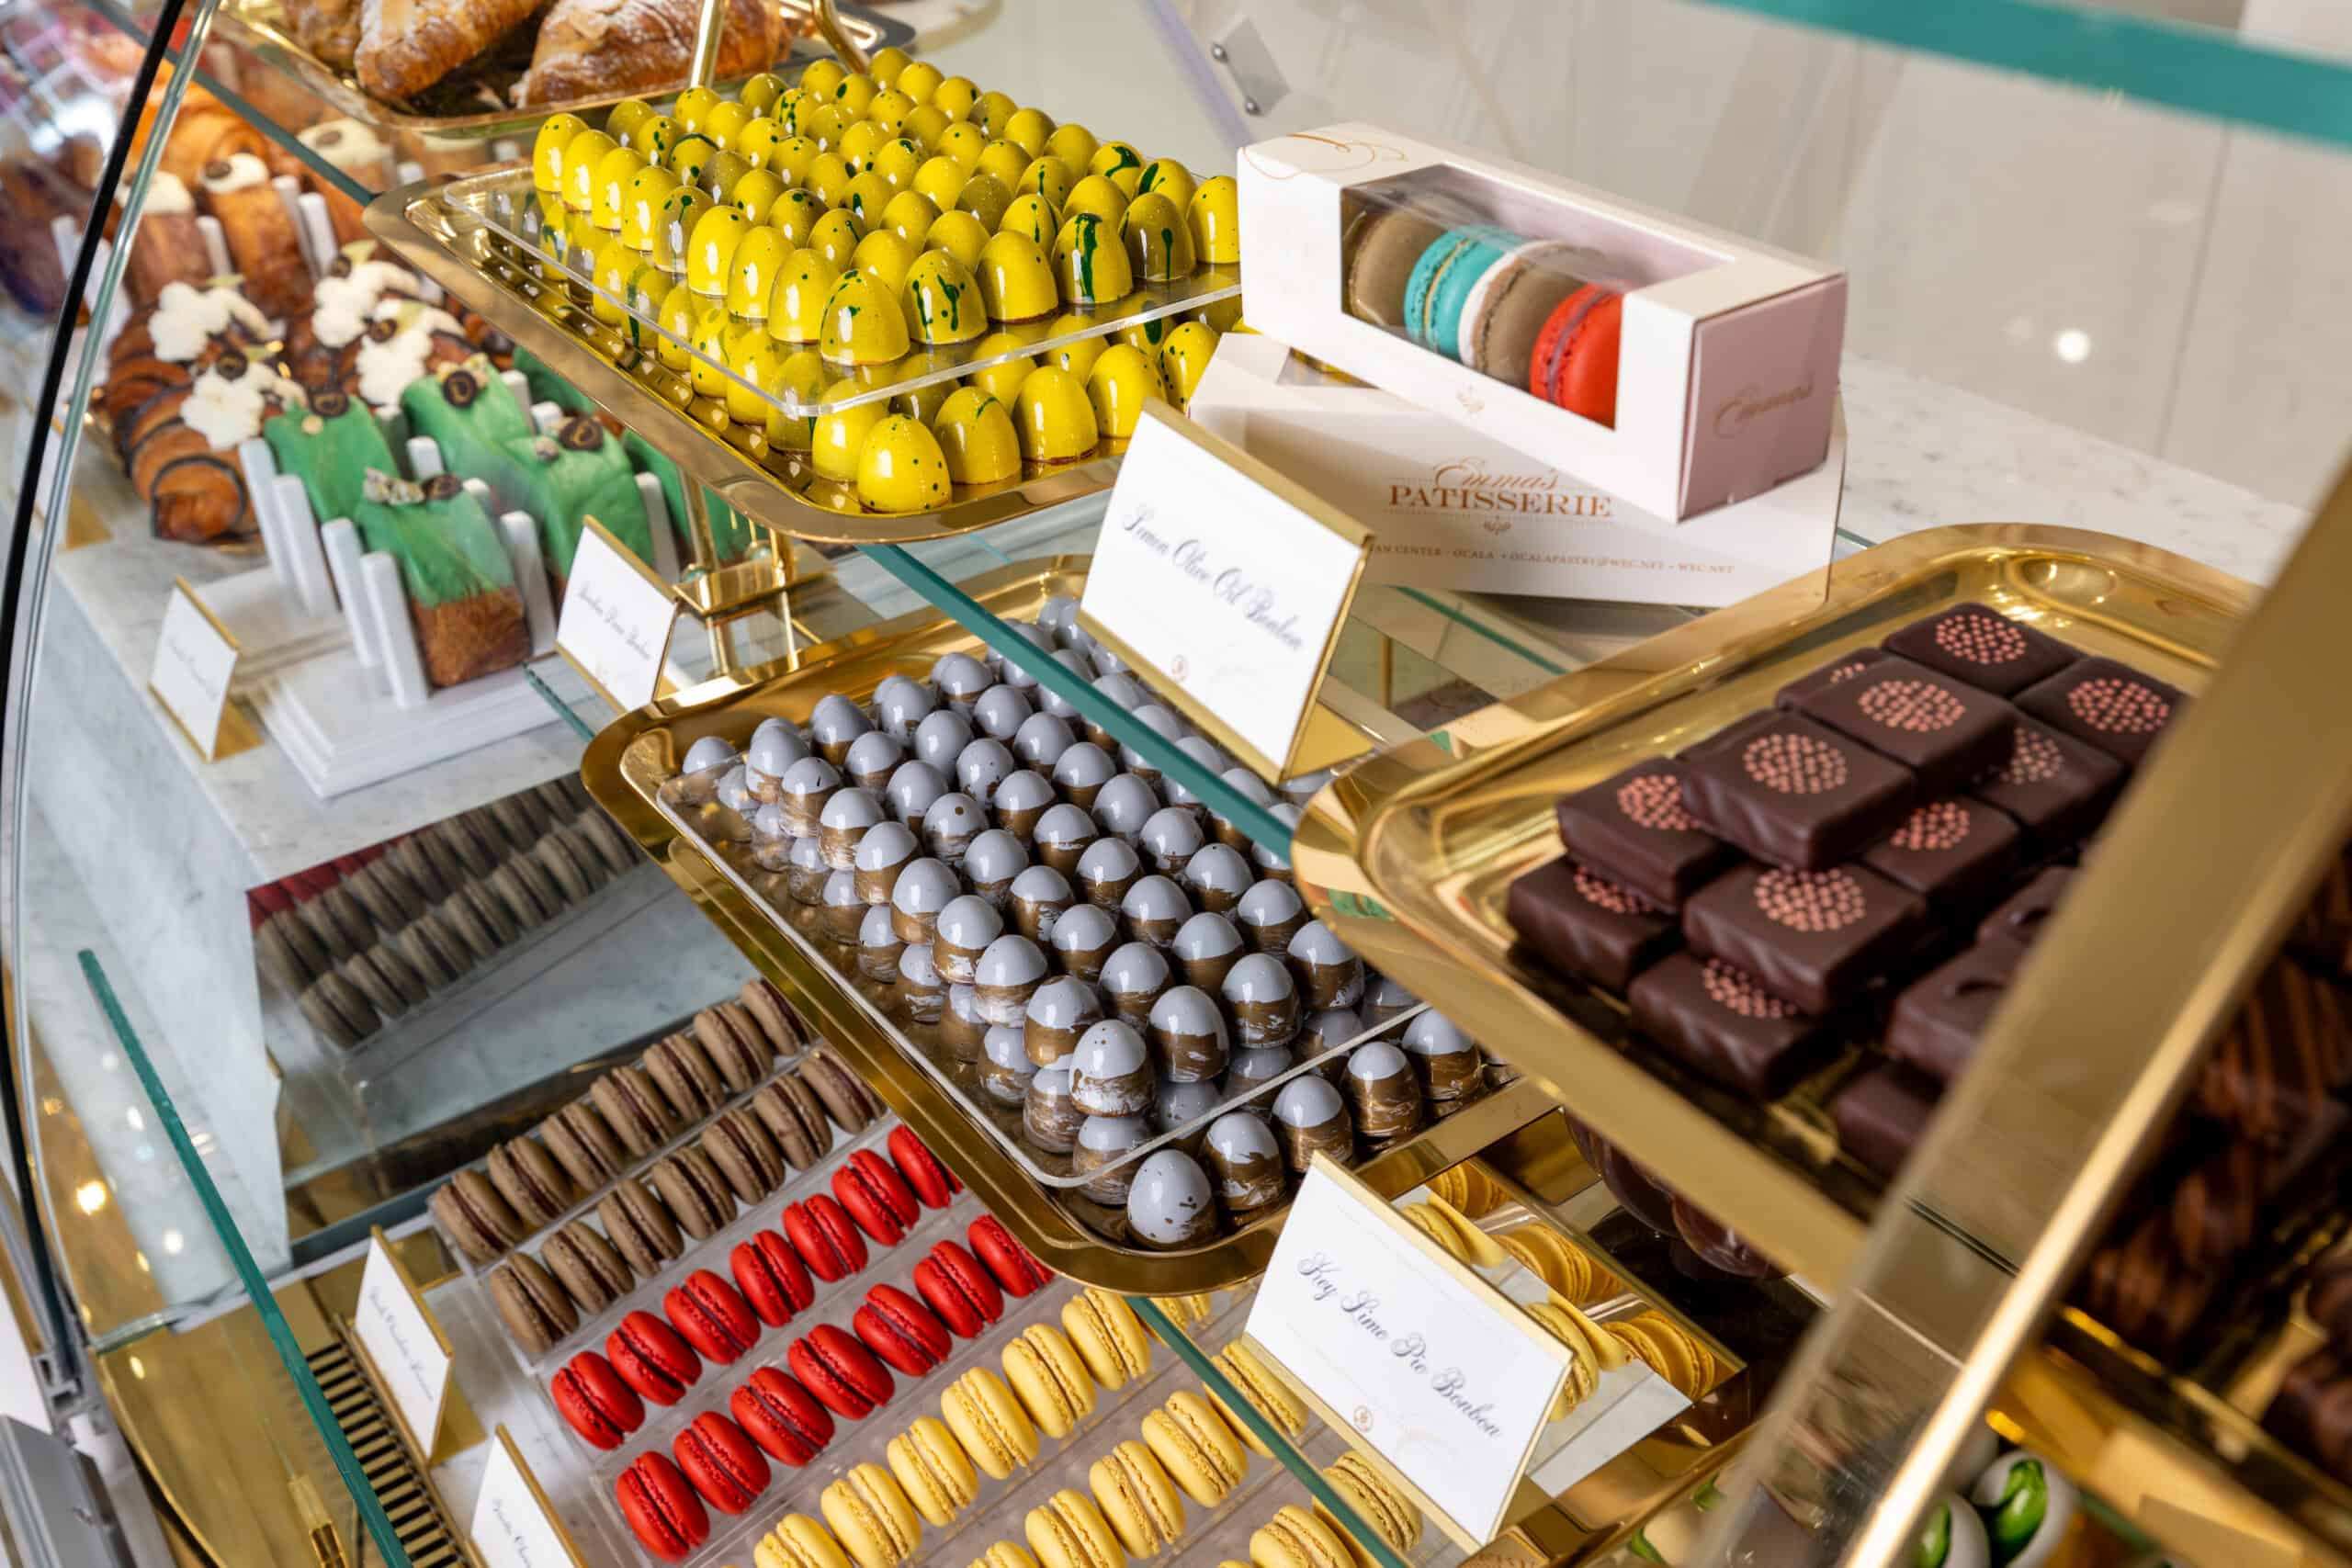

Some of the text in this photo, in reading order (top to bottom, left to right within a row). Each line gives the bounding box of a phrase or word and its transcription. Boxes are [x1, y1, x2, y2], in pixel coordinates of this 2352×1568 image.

[1389, 484, 1611, 517] PATISSERIE
[1433, 457, 1559, 491] Emma's
[1213, 567, 1254, 605] Oil
[1244, 588, 1305, 650] Bonbon
[1297, 1251, 1501, 1439] Key Lime Pie Bonbon
